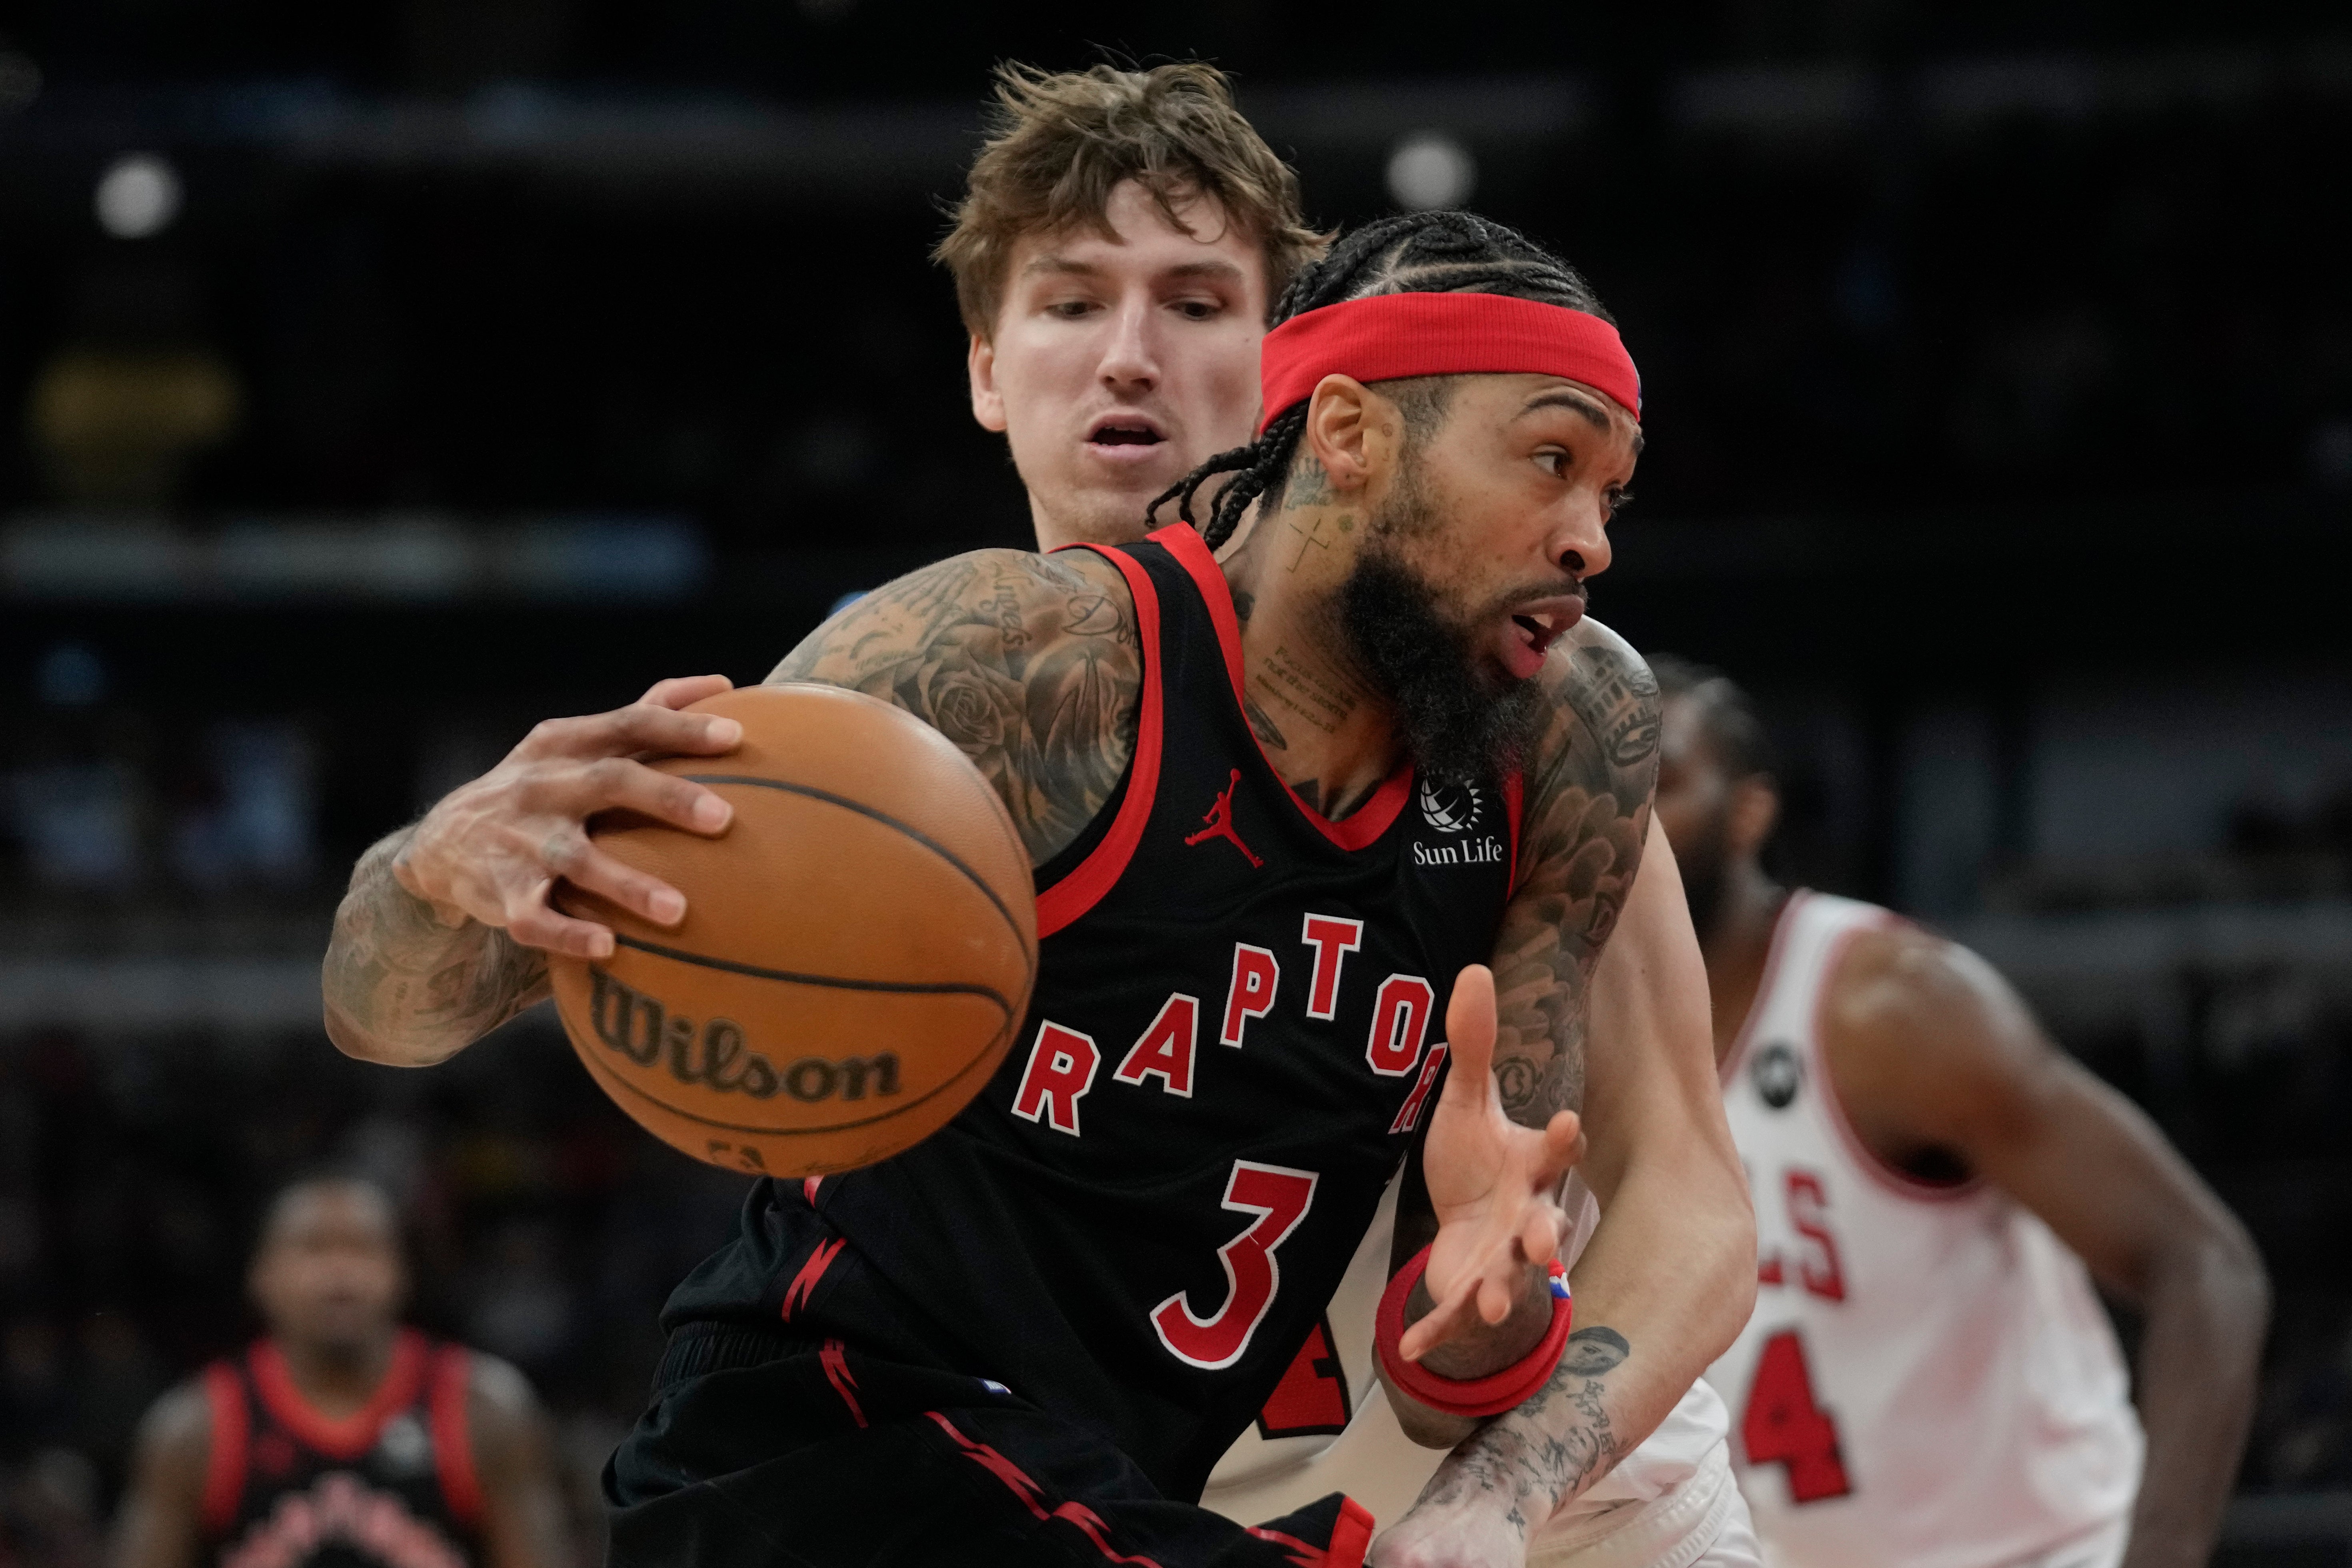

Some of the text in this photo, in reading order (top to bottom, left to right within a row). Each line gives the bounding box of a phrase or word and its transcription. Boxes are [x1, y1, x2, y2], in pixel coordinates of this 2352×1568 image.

[1413, 835, 1503, 865] Sun Life
[589, 964, 902, 1103] Wilson
[1011, 912, 1449, 1137] RAPTOR
[1150, 1159, 1320, 1370] 3
[1741, 1324, 1855, 1506] 4
